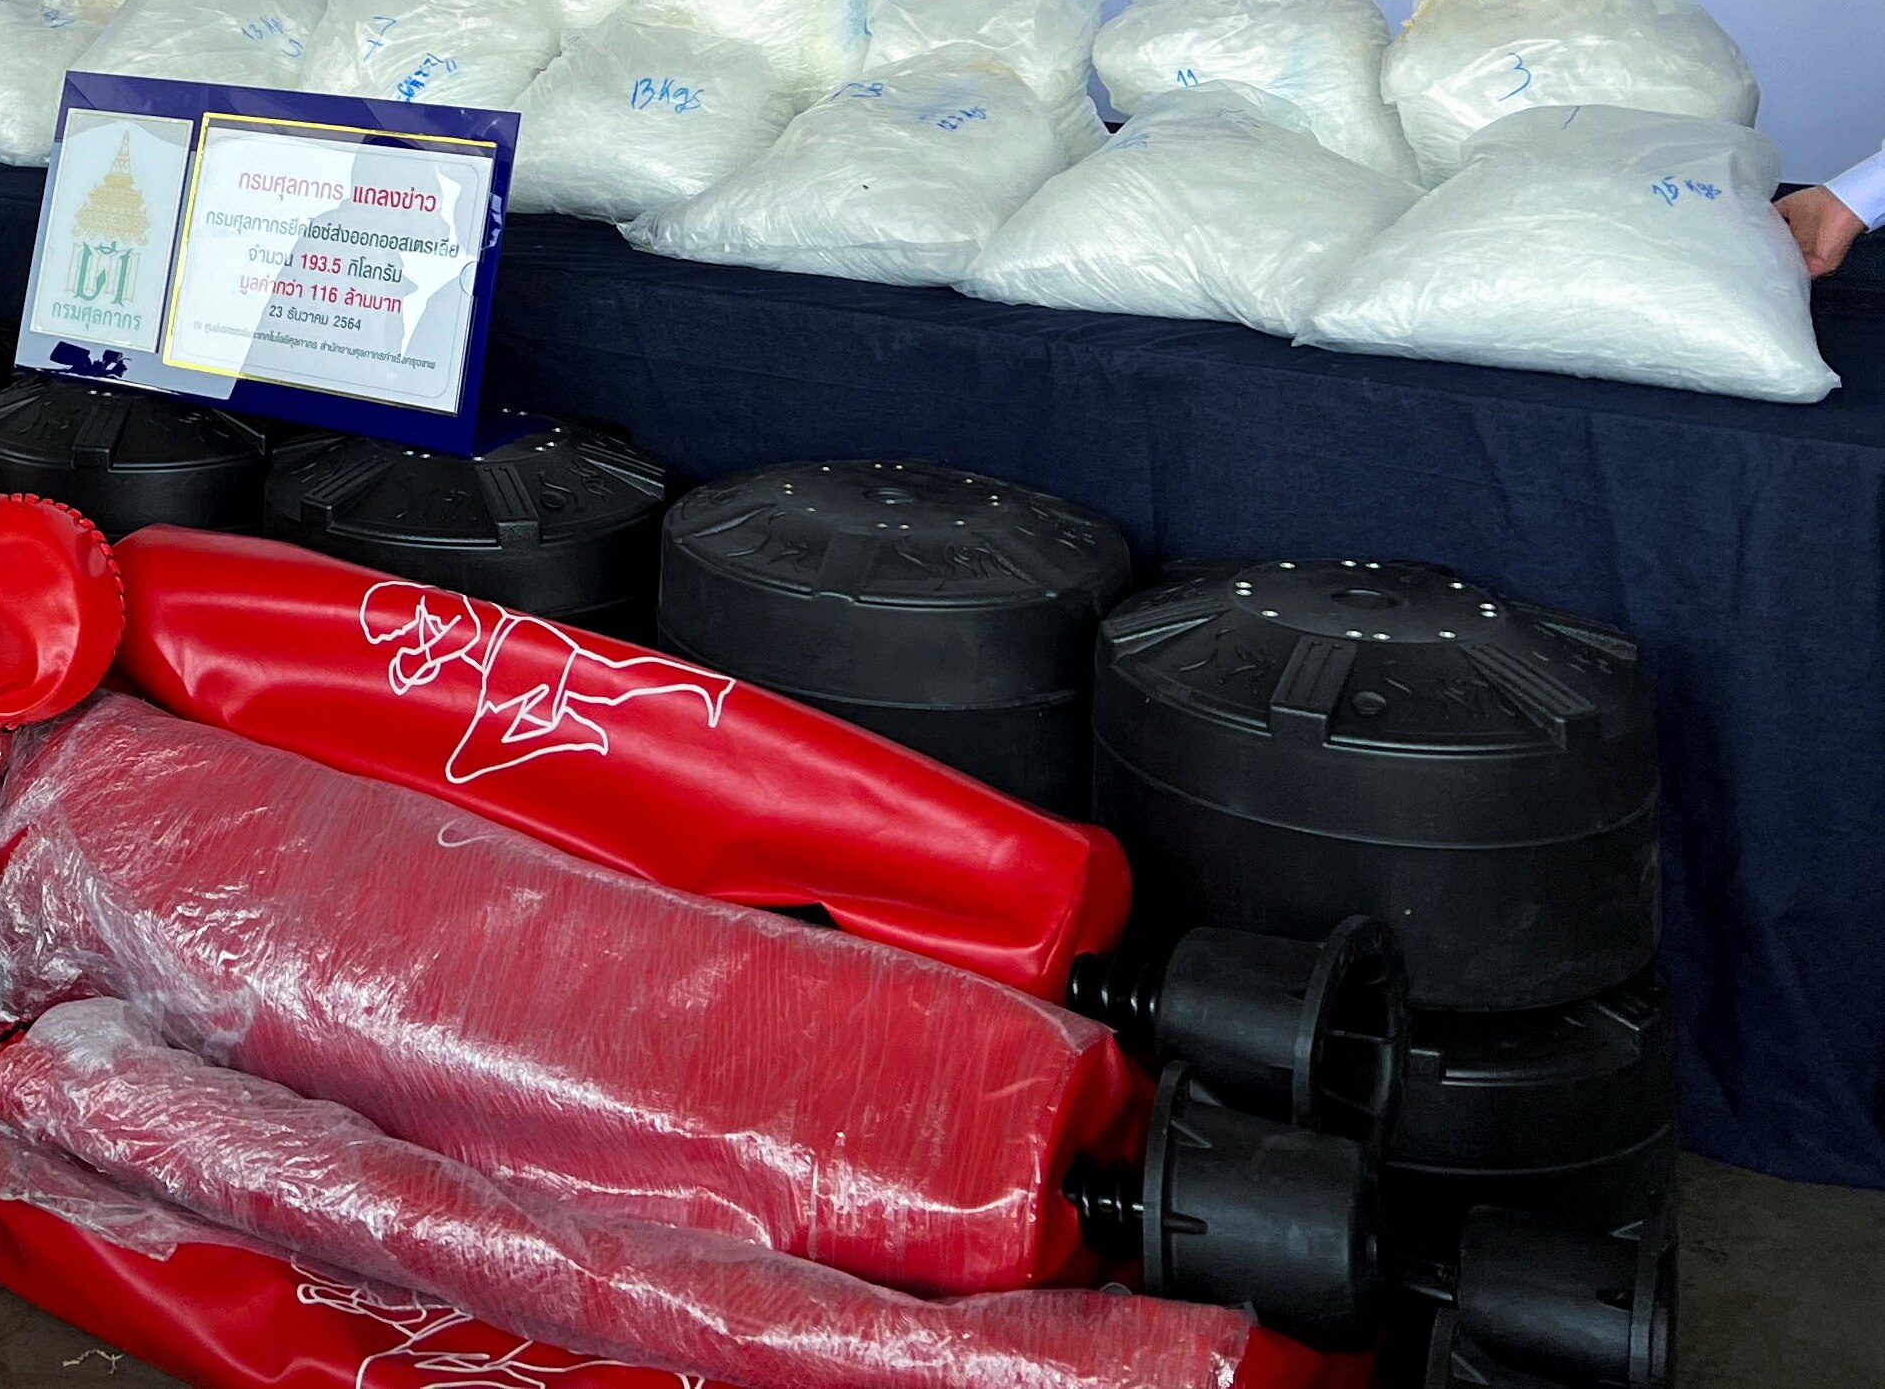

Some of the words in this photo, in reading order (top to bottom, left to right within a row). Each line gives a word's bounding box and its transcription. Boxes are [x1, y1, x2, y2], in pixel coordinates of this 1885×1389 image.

[1497, 52, 1532, 102] 3
[238, 171, 344, 202] กรมศุลกากร
[352, 184, 437, 213] แถลงข่าว
[205, 210, 460, 259] กรมศุลกากรยึดไอซ์ส่งออกออสเตรเลีย
[247, 245, 294, 268] จำนวน
[300, 252, 342, 275] 193.5
[347, 256, 404, 284] กิโลกรัม
[239, 273, 304, 299] มูลค่ากว่า
[310, 283, 340, 304] 116
[344, 287, 403, 314] ล้านบาท
[51, 301, 142, 332] กรมศุลกากร
[268, 304, 283, 319] 23
[287, 307, 329, 326] ธันวาคม
[333, 315, 363, 332] 2564
